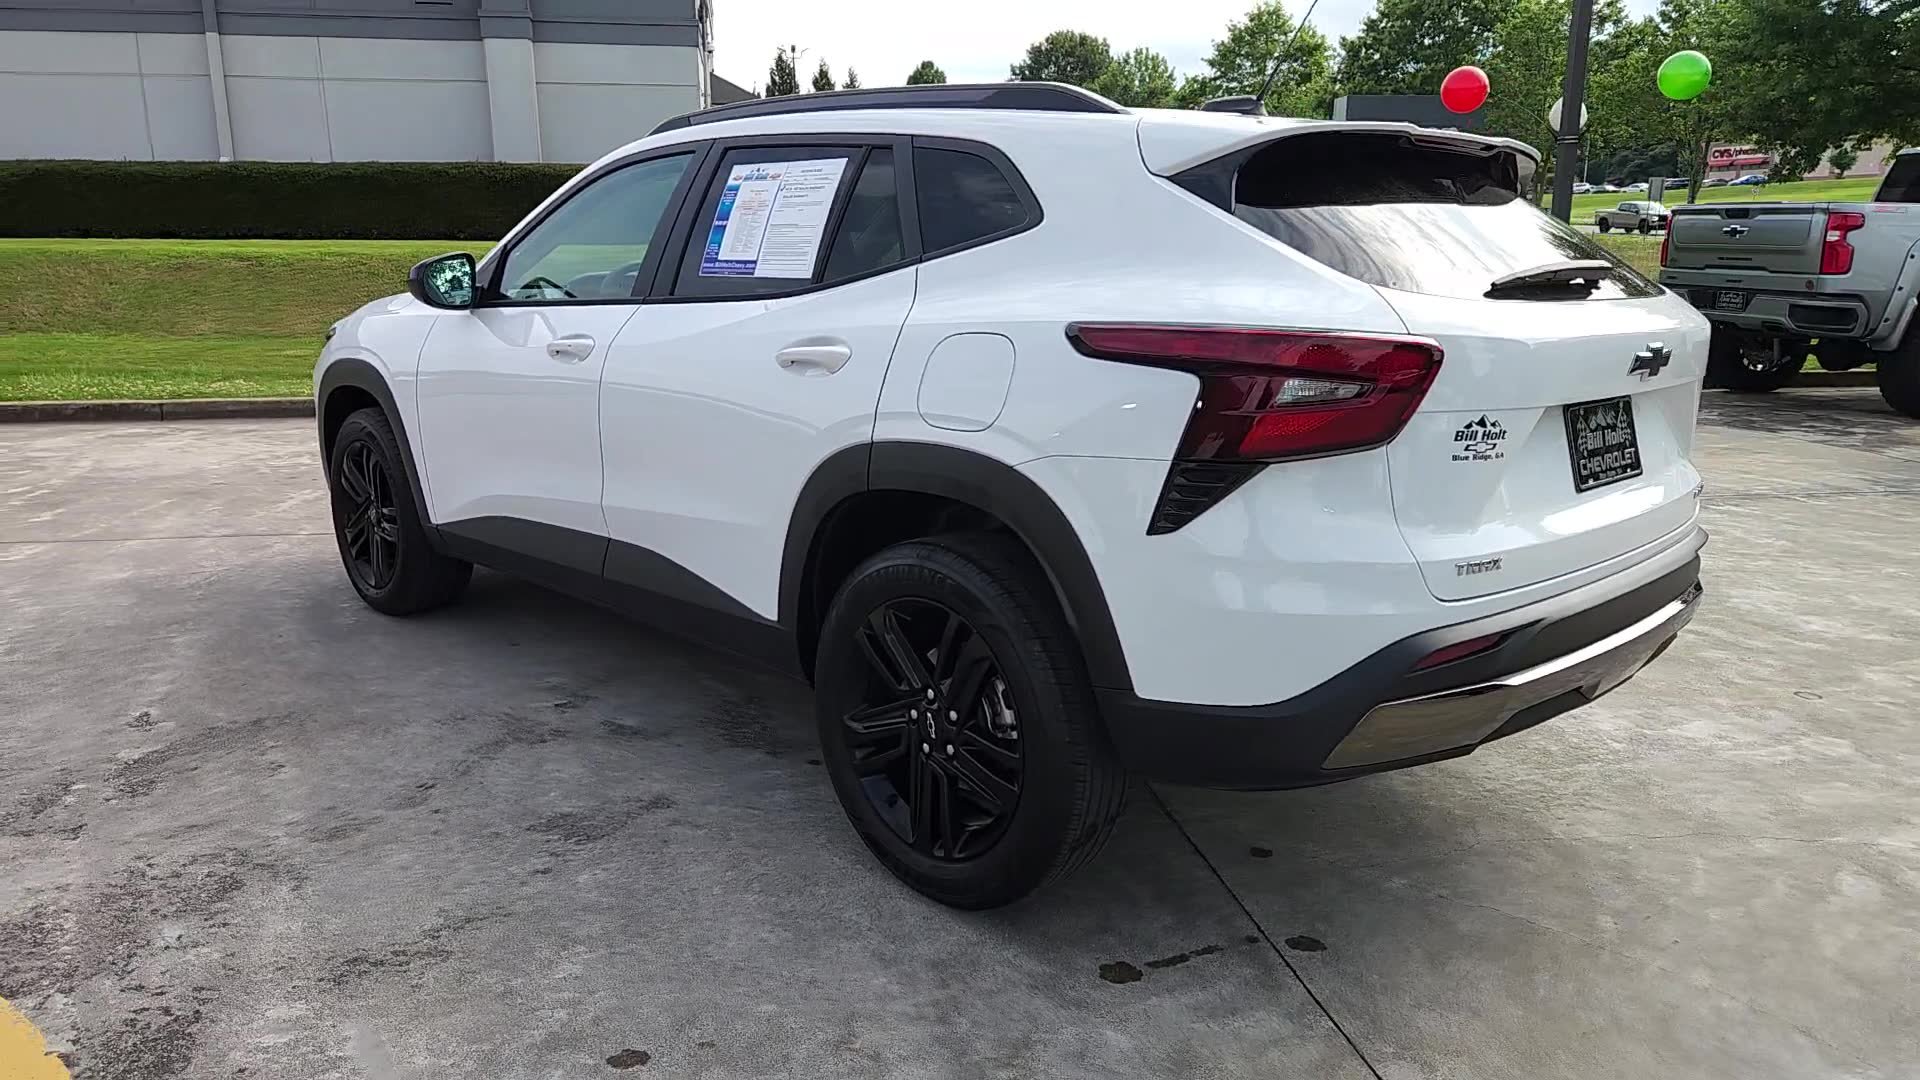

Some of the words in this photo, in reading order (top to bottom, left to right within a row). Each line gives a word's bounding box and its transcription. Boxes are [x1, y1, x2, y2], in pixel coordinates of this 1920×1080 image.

[1453, 430, 1479, 442] Bill
[1481, 428, 1508, 441] Holt
[1587, 431, 1604, 450] Bill
[1604, 427, 1624, 446] Holt
[1580, 448, 1636, 476] CHEVROLET
[1455, 557, 1503, 576] TRAX
